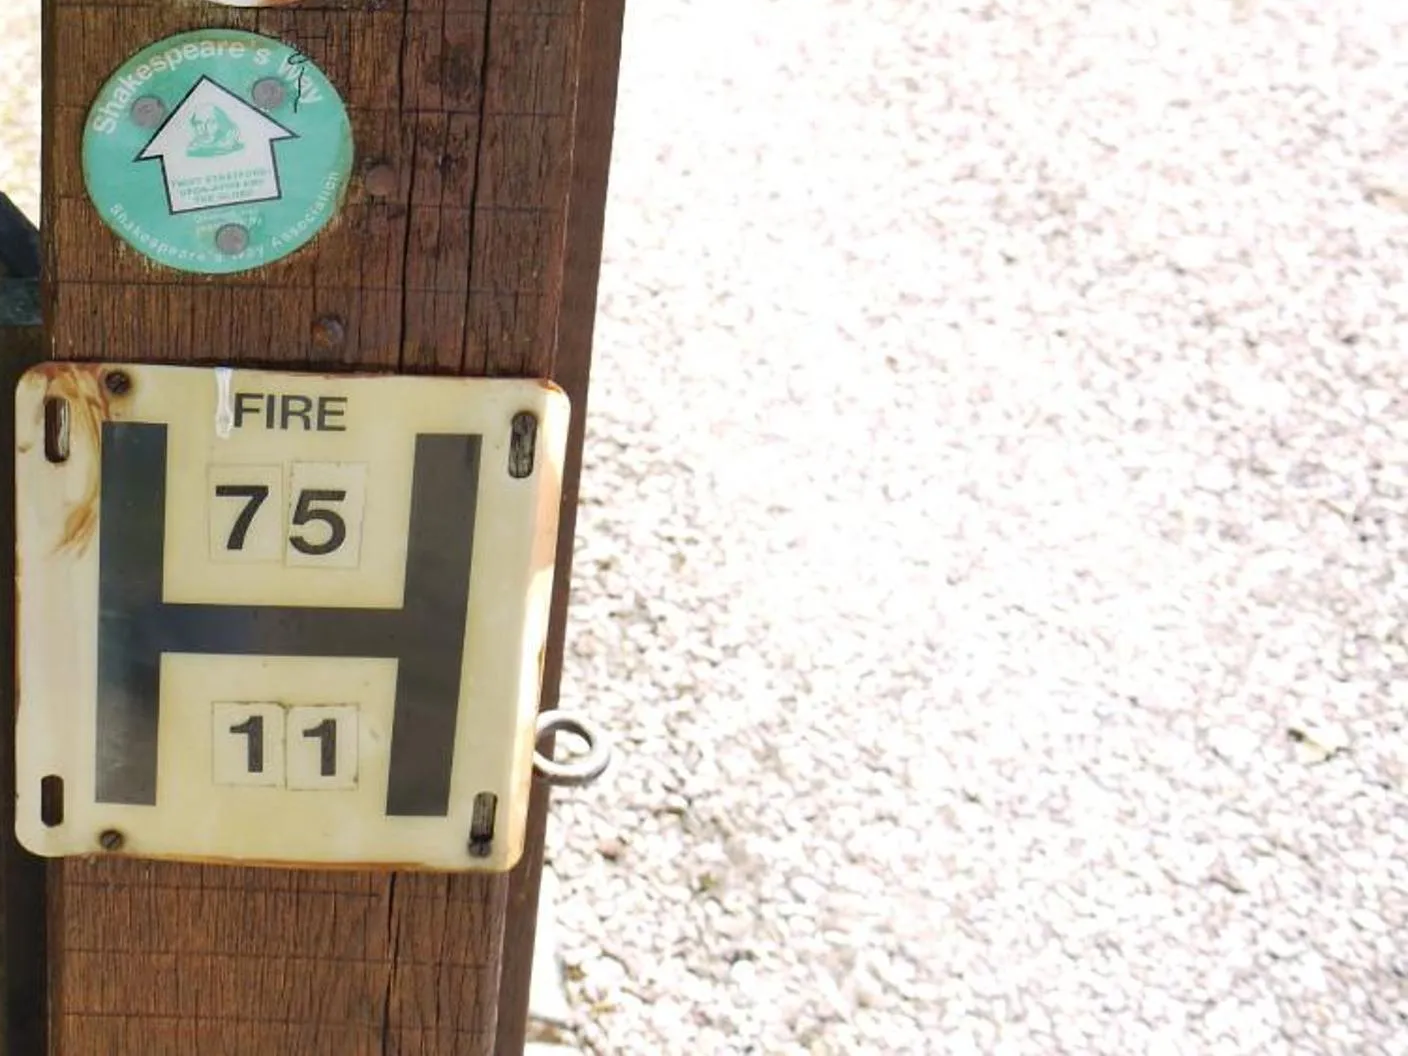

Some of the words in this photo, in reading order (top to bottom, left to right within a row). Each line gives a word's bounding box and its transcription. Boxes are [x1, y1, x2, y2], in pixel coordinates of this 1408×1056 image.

[277, 54, 323, 104] Way
[233, 392, 349, 433] FIRE
[214, 484, 347, 556] 75
[228, 714, 338, 778] 11
